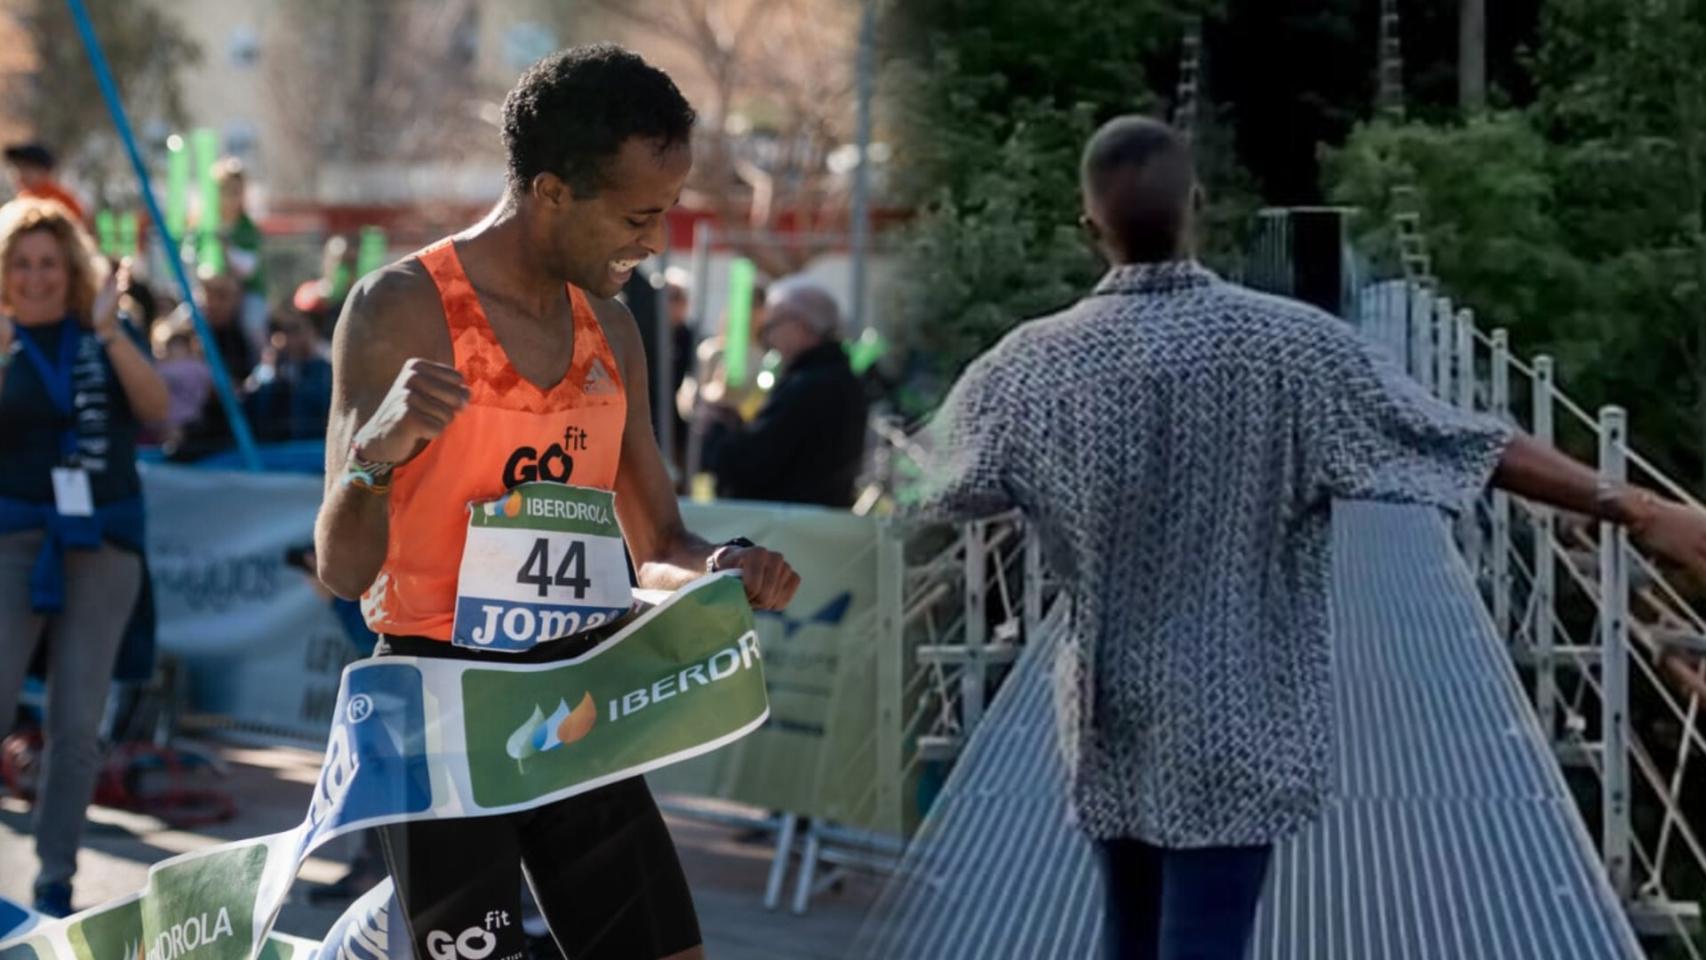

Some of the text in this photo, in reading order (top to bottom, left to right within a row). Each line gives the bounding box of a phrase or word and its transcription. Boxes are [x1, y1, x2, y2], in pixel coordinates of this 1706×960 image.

[502, 426, 588, 490] GO fit
[526, 497, 612, 525] IBERDROLA
[516, 537, 592, 600] 44
[426, 909, 511, 960] GO fit
